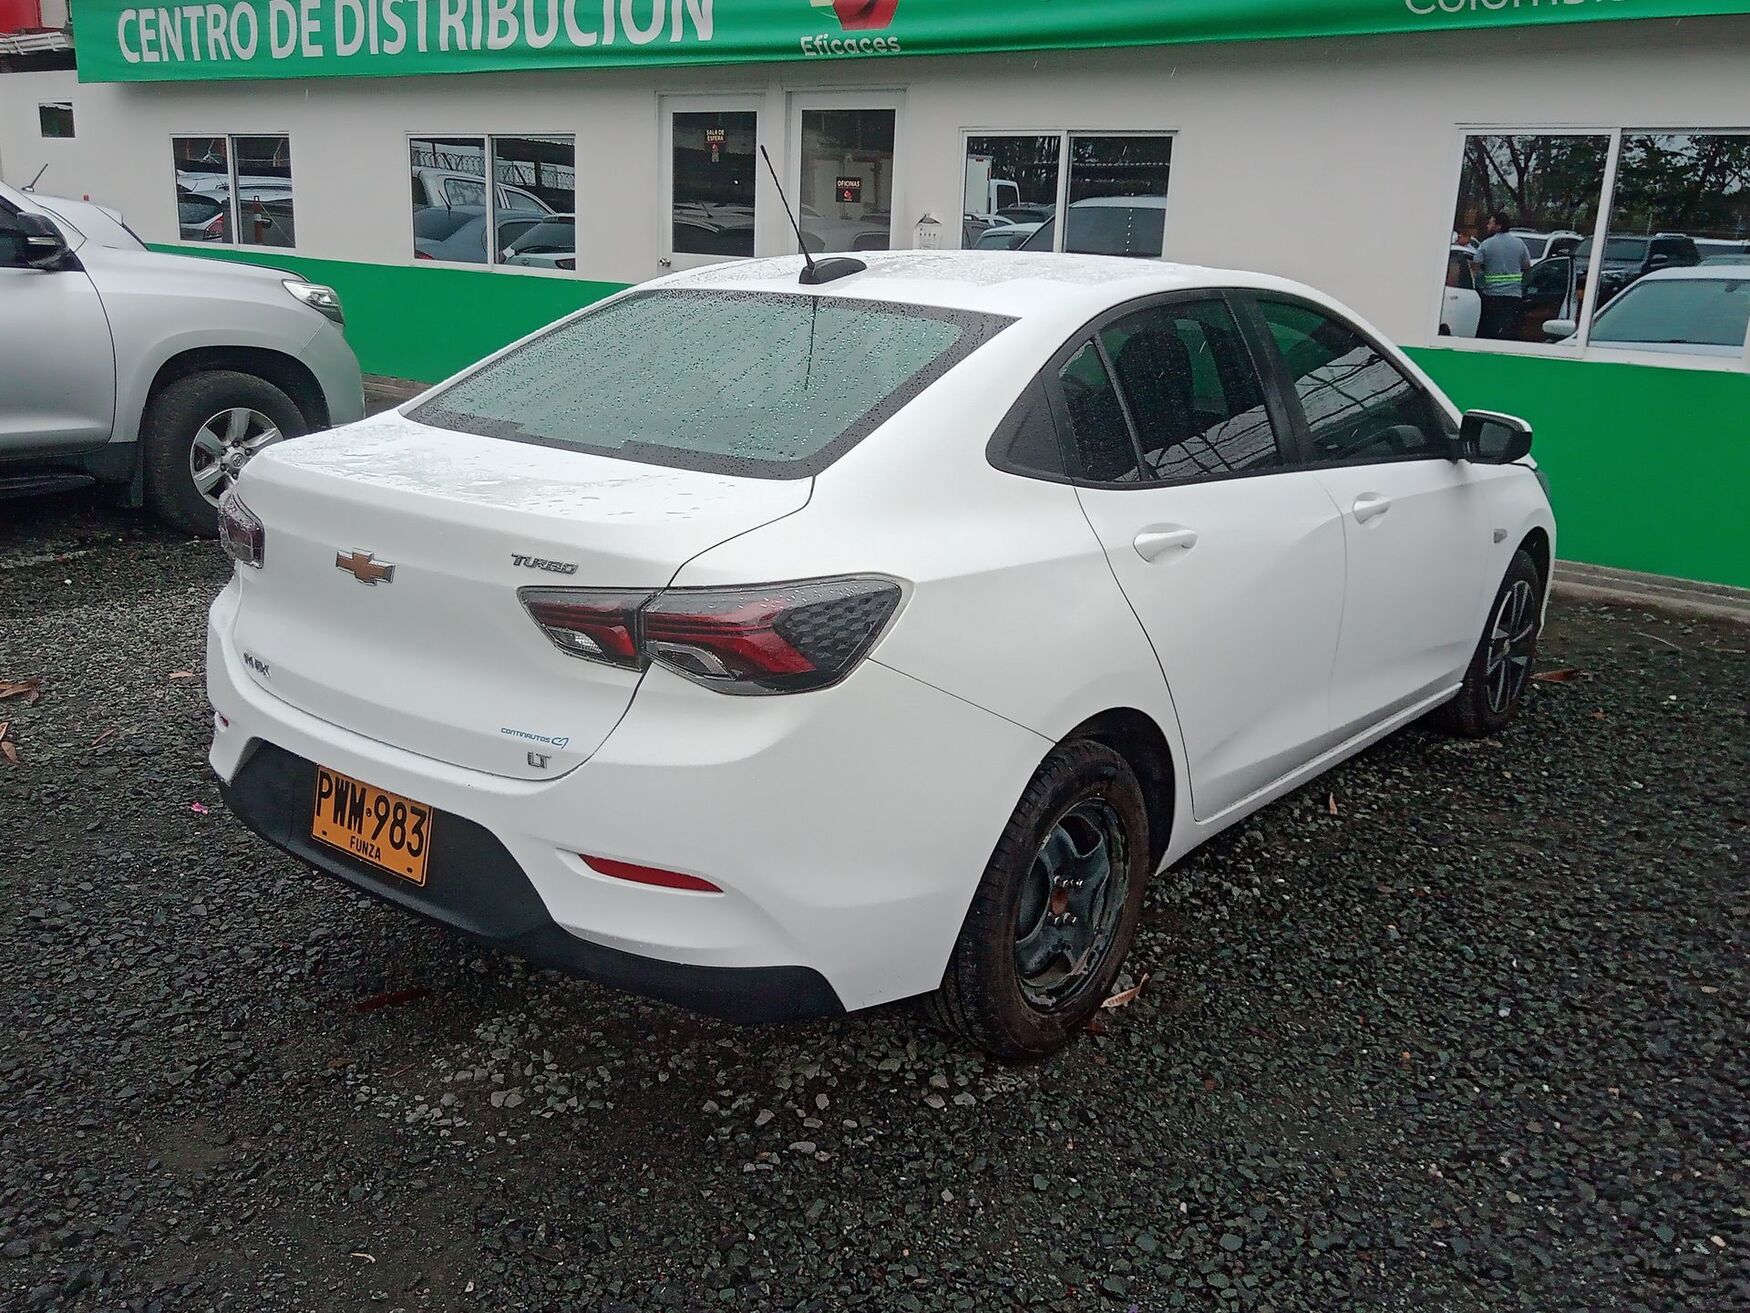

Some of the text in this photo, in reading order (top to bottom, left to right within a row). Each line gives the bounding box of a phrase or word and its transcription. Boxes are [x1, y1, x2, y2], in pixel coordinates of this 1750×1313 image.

[117, 1, 258, 63] CENTRO
[269, 0, 324, 59] DE
[800, 33, 901, 56] Eficaces
[511, 553, 579, 575] TURBO
[527, 751, 551, 769] LT
[349, 835, 381, 861] FUNZA
